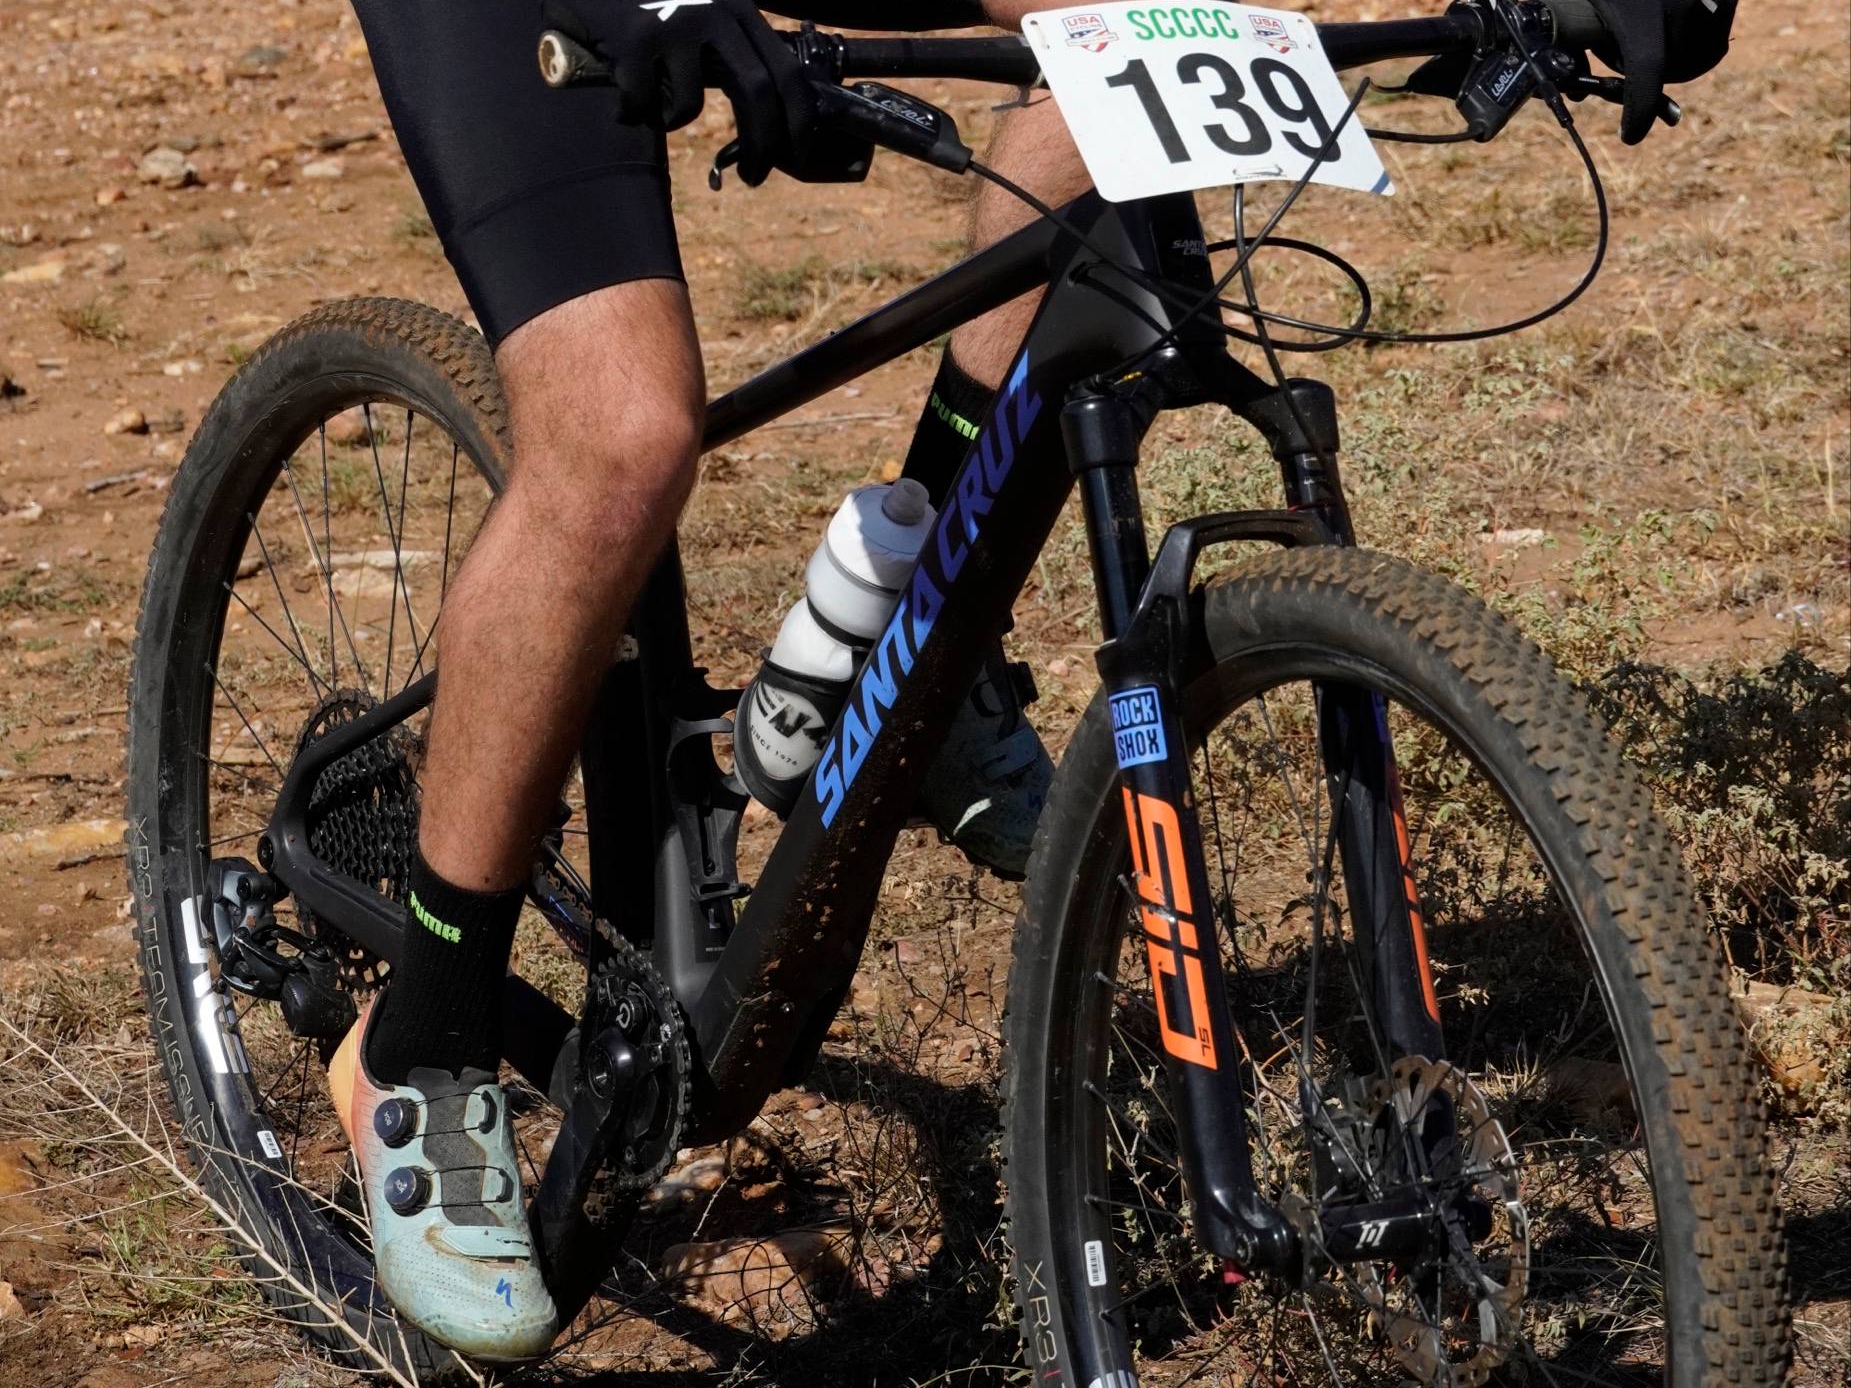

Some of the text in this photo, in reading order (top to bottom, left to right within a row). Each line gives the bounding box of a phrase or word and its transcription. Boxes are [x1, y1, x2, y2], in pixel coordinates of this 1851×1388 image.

[1067, 16, 1102, 27] USA
[1126, 7, 1239, 41] SCCCC
[1253, 17, 1281, 30] USA
[1105, 52, 1342, 164] 139
[814, 348, 1043, 830] SANTA CRUZ
[1111, 695, 1157, 730] ROCK
[1117, 728, 1161, 761] SHOX
[410, 890, 462, 943] PUMA
[143, 916, 174, 1037] TEAM
[1198, 1025, 1210, 1058] SL
[1023, 1259, 1058, 1364] XR3
